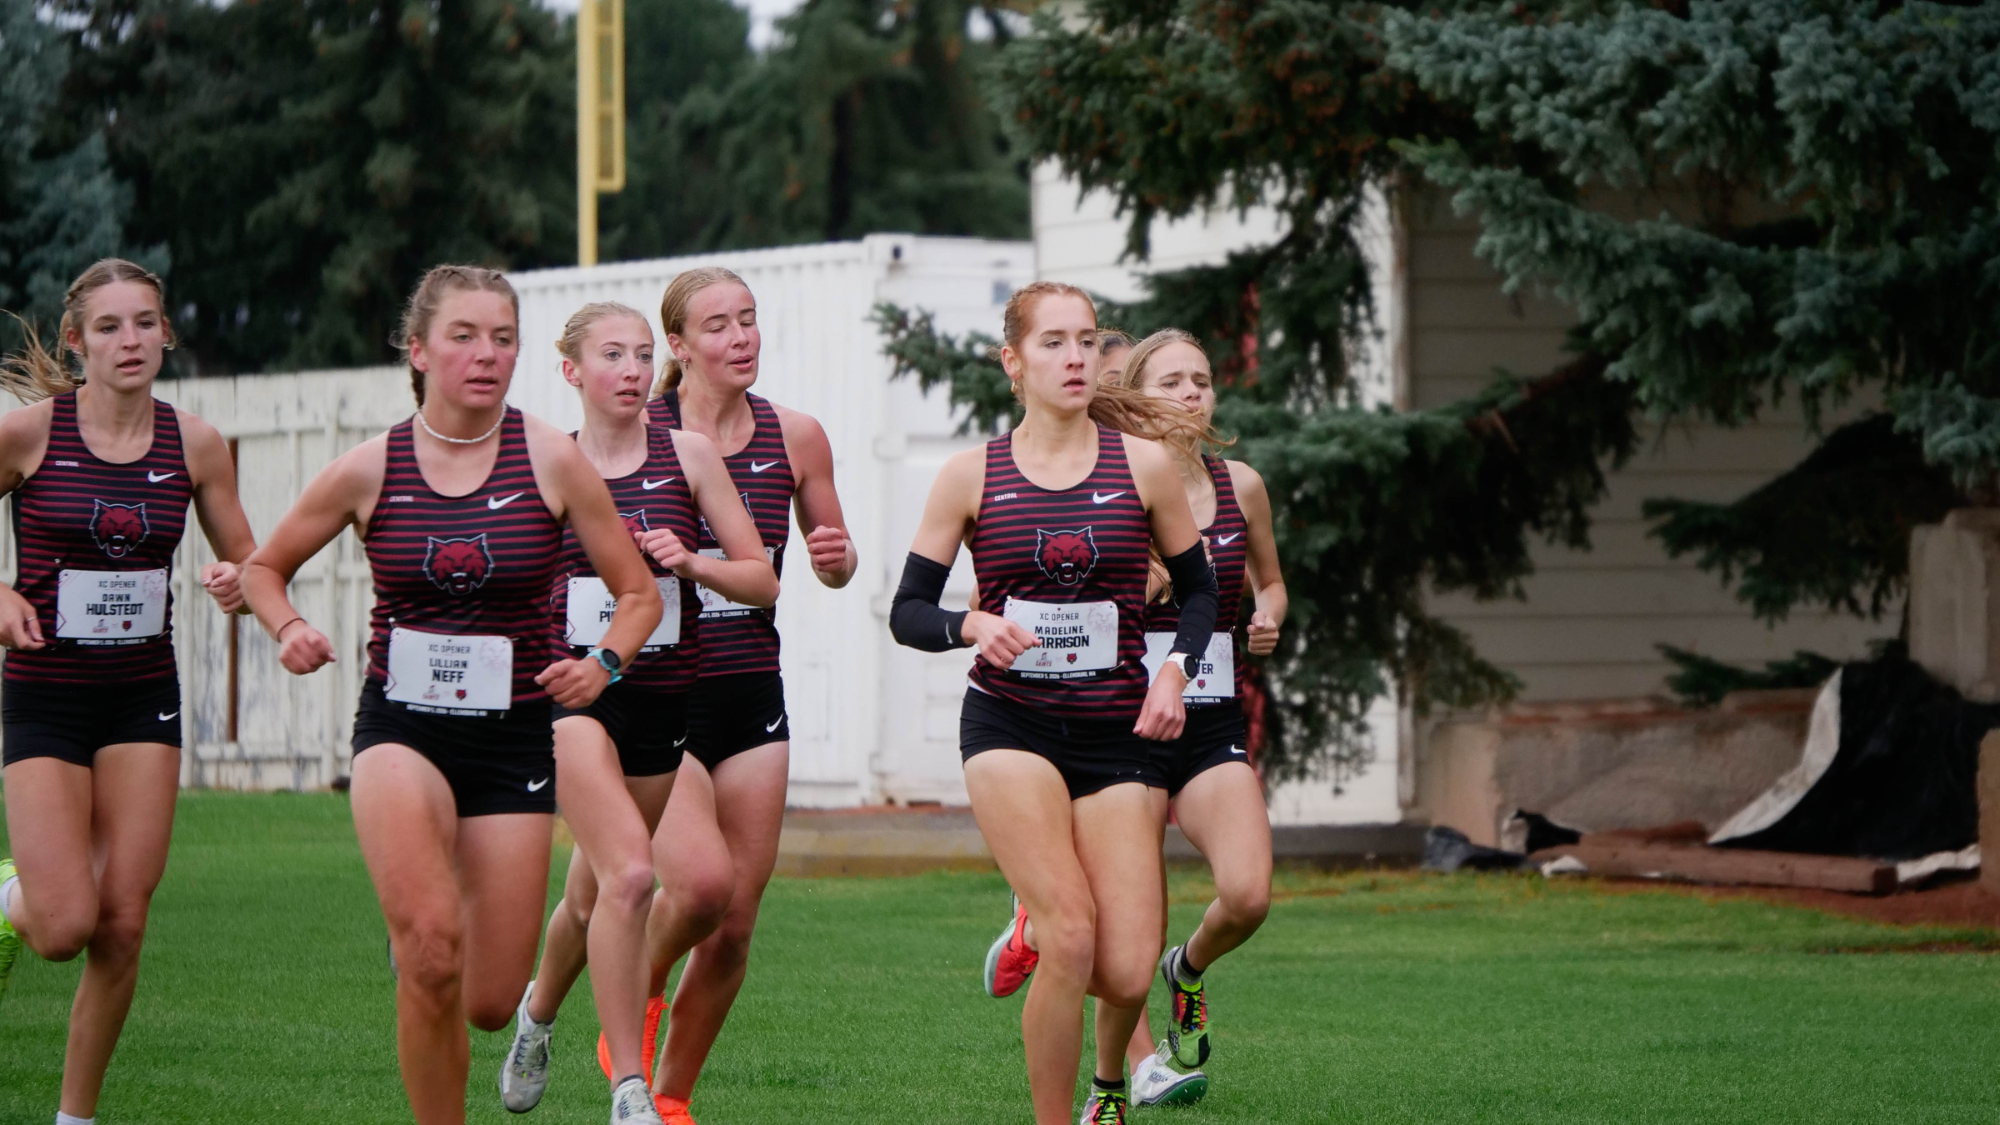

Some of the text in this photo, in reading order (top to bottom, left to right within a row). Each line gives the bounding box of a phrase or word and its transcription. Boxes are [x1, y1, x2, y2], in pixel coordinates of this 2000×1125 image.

[995, 492, 1018, 501] CENTRAL
[102, 594, 131, 602] DAWN
[86, 603, 144, 616] HULSTEDT
[1051, 613, 1079, 621] OPENER
[1035, 626, 1084, 635] MADELINE
[1033, 635, 1090, 649] ARRISON
[428, 644, 470, 654] XC OPENER
[429, 658, 468, 669] LILLIAN
[432, 669, 465, 683] NEFF
